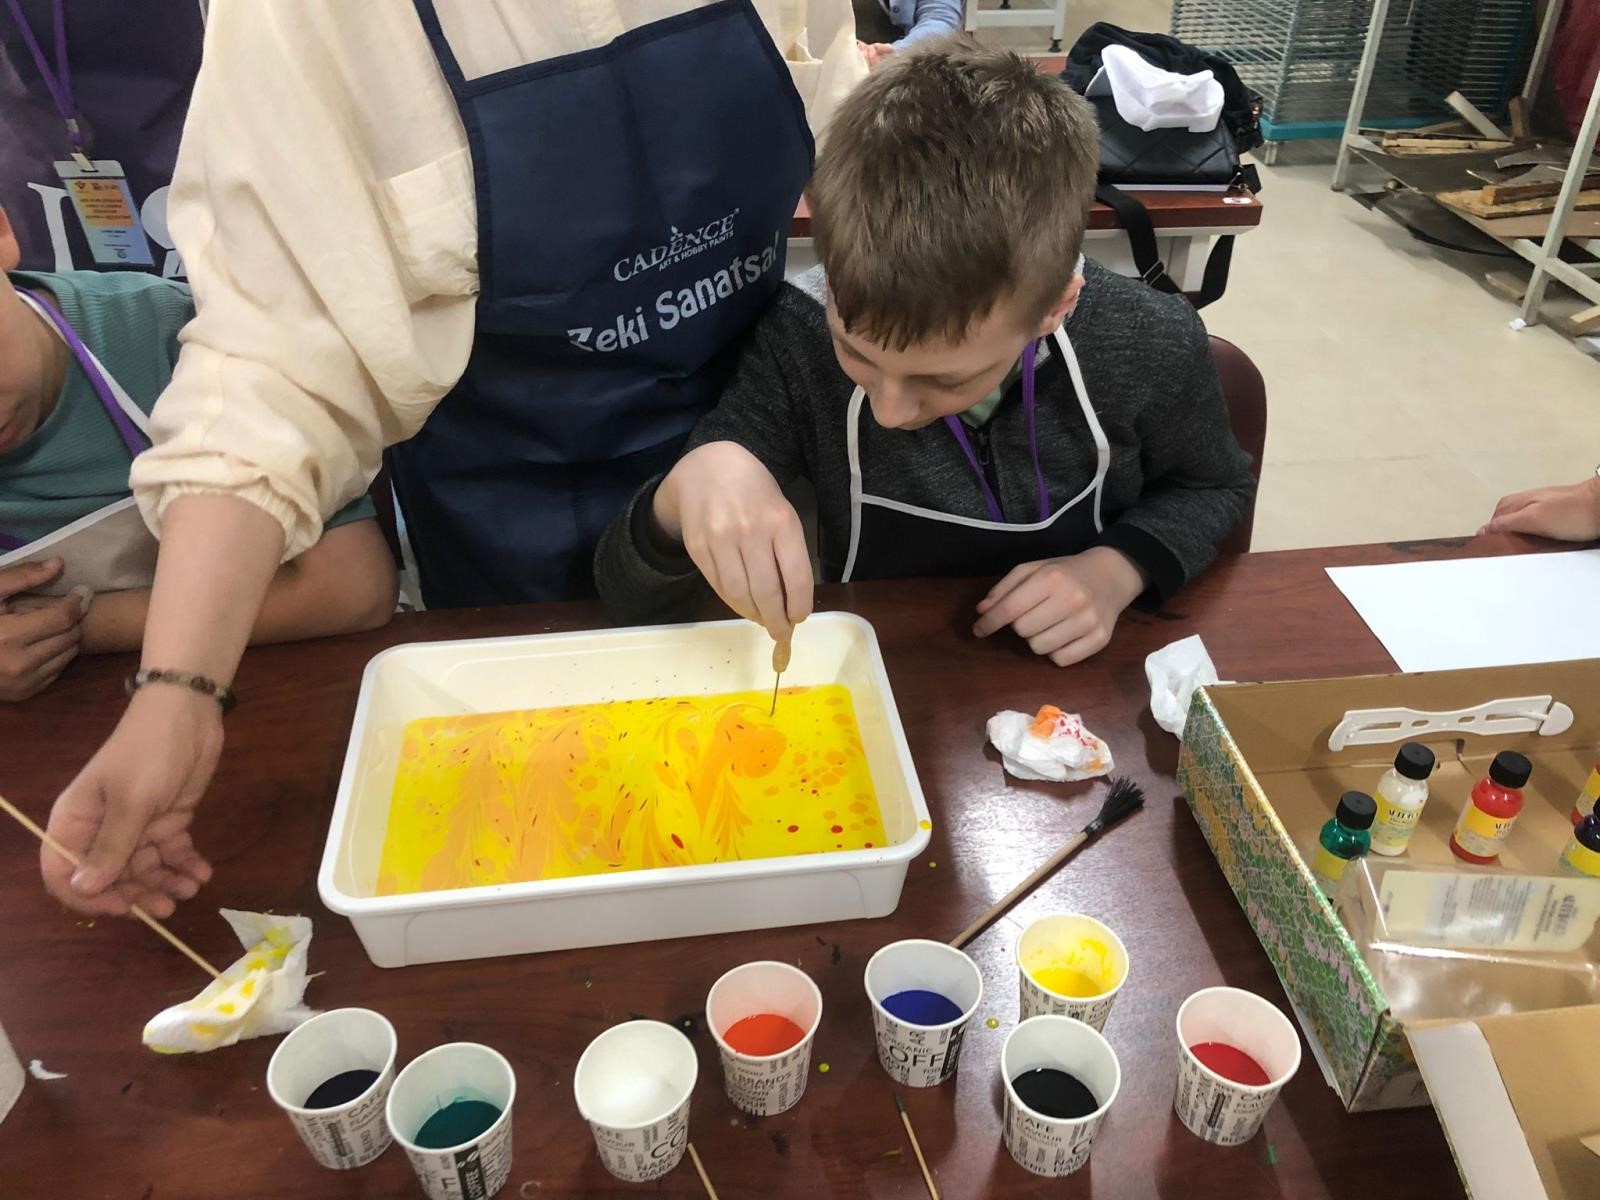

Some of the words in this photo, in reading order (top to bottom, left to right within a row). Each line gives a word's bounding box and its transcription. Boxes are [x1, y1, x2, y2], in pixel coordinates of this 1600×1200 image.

[614, 213, 735, 282] CADENCE
[659, 257, 674, 271] ART
[681, 243, 708, 260] HOBBY
[709, 229, 735, 248] PAINTS
